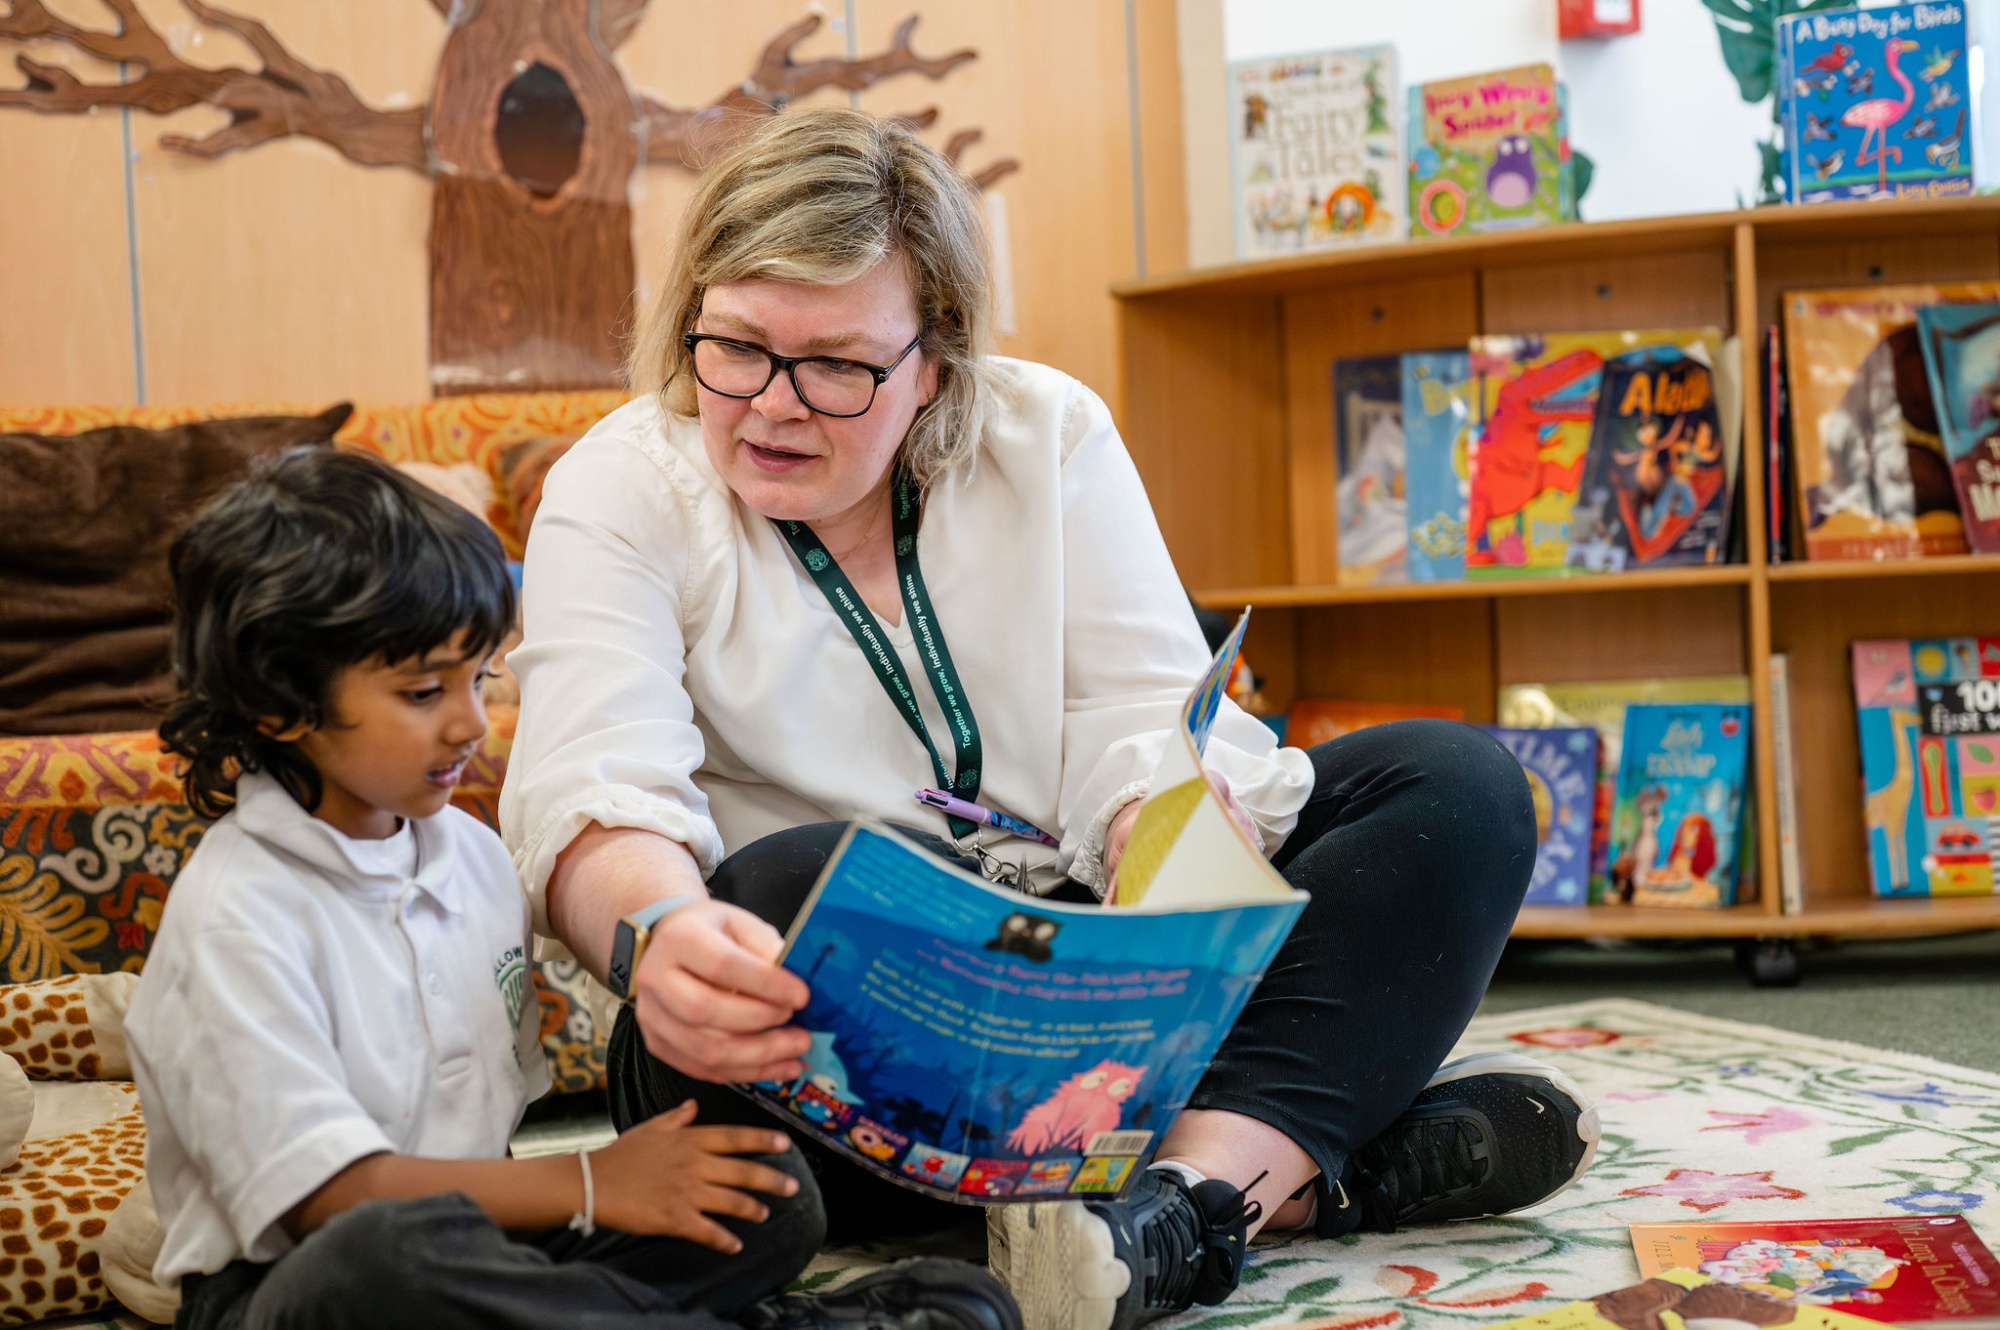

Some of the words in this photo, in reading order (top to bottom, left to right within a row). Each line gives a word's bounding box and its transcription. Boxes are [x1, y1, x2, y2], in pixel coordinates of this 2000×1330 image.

[1796, 20, 1813, 43] A
[1813, 15, 1856, 41] Busy
[1858, 12, 1889, 39] Day
[1889, 11, 1912, 35] for
[1913, 4, 1962, 30] Birds
[835, 586, 855, 611] shine
[906, 573, 917, 600] shine
[851, 610, 864, 625] we
[912, 600, 922, 615] we
[860, 624, 895, 675] Individually
[917, 615, 942, 669] Individually
[892, 673, 910, 699] grow,
[937, 668, 954, 693] grow,
[906, 699, 917, 714] we
[947, 694, 958, 708] we
[953, 708, 972, 748] Together
[1931, 702, 1981, 735] first
[1903, 1236, 1939, 1263] Large
[1921, 1263, 1955, 1278] In
